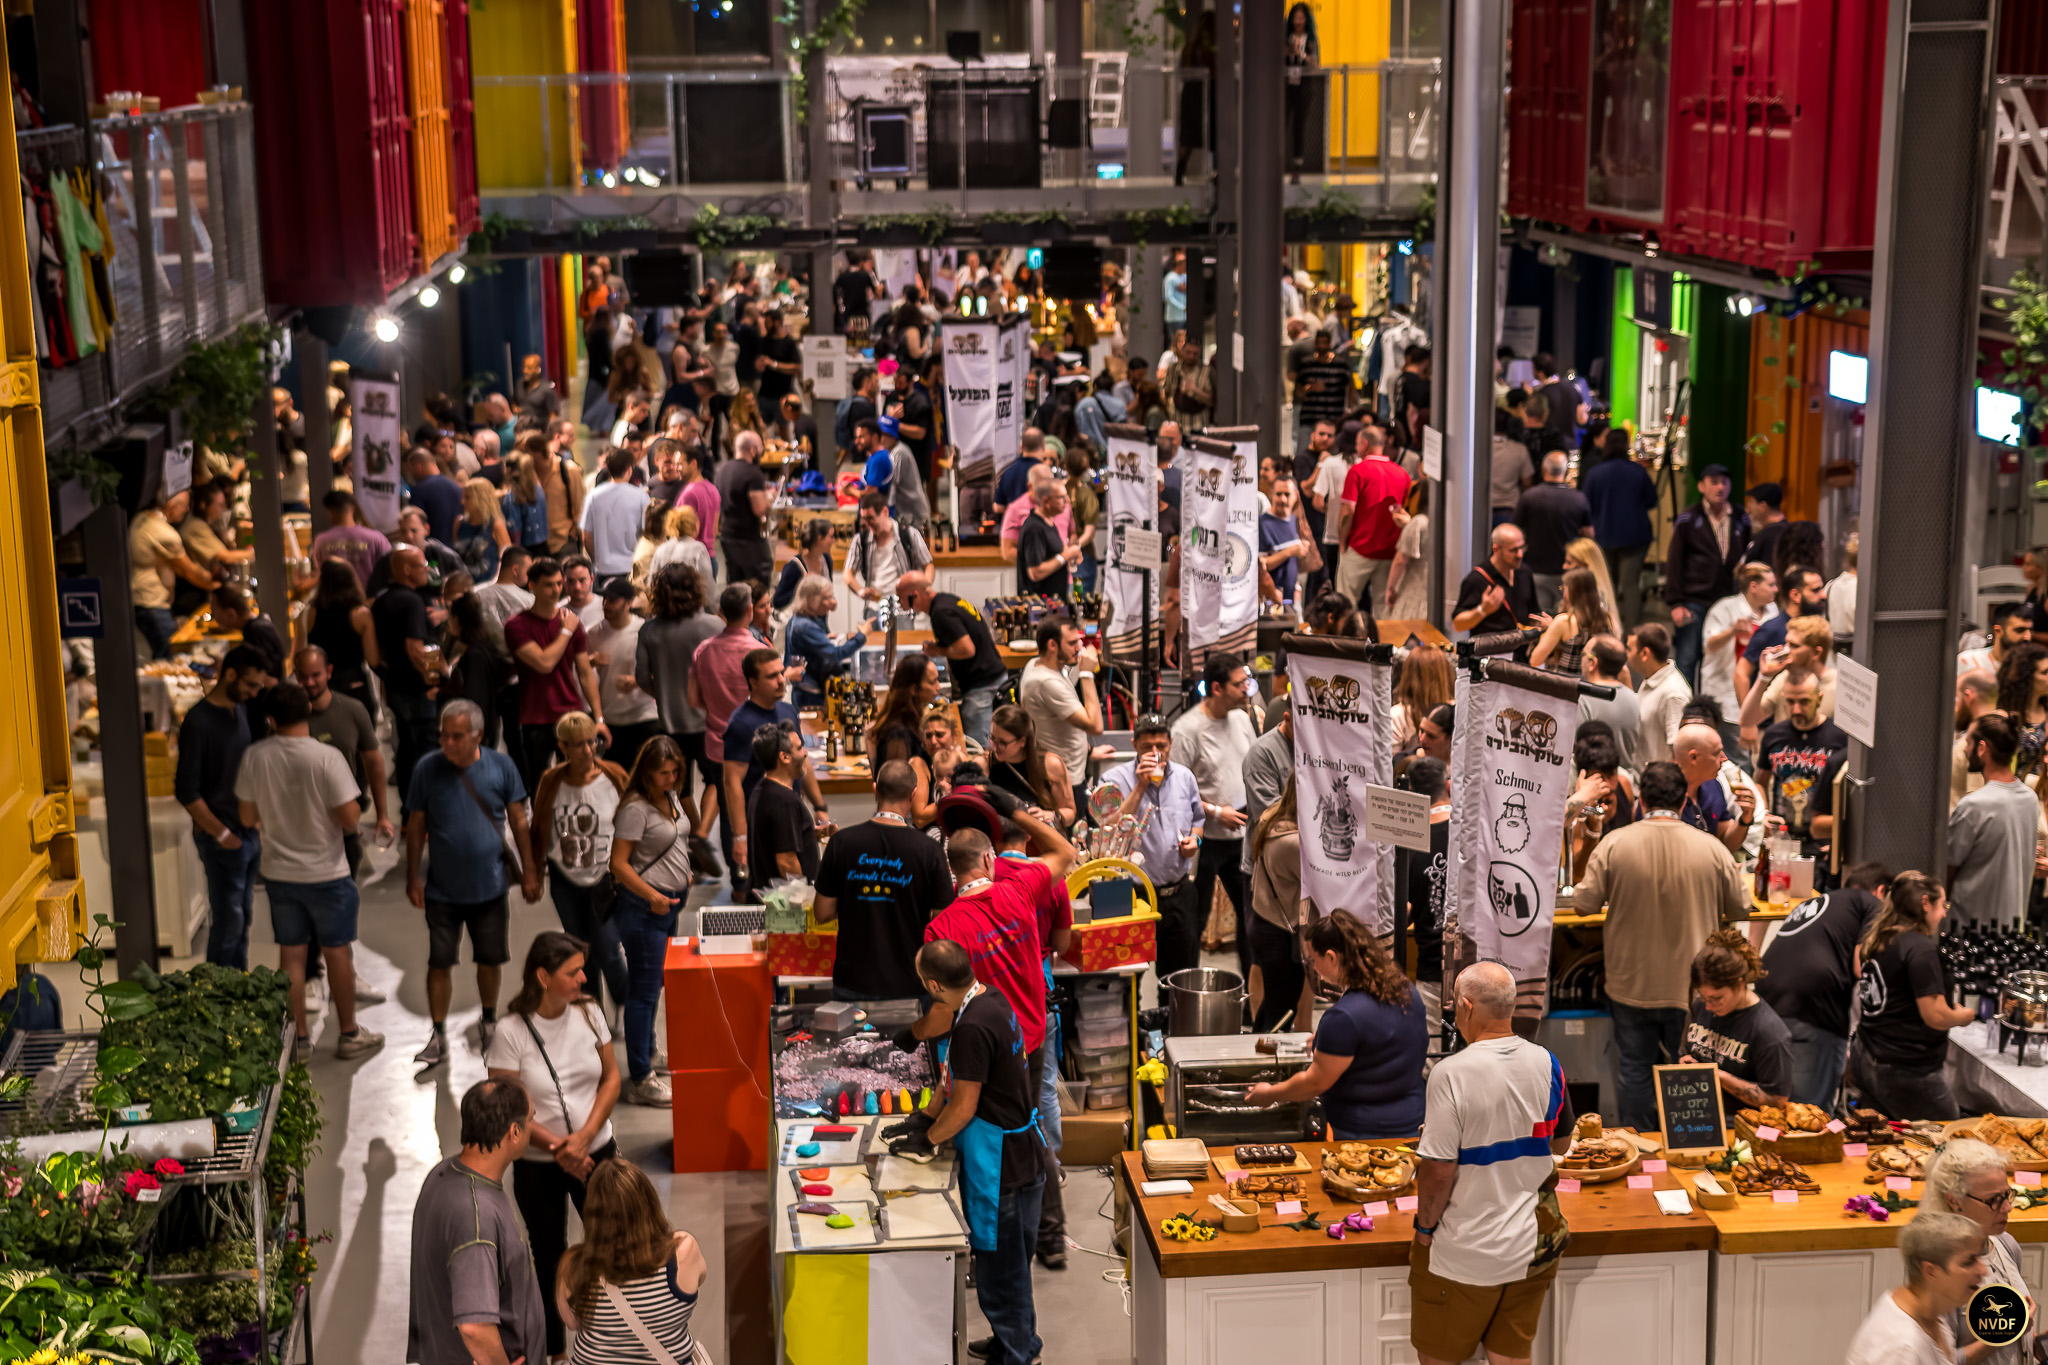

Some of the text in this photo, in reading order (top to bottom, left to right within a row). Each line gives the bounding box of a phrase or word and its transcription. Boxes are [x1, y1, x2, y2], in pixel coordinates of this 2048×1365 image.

[949, 384, 990, 402] הפועל
[1296, 704, 1336, 720] הבירה
[1486, 734, 1565, 767] שוק הבירה
[858, 852, 904, 871] Everybody
[847, 869, 913, 888] Kneads Candy!
[1670, 1110, 1706, 1125] בוטיק
